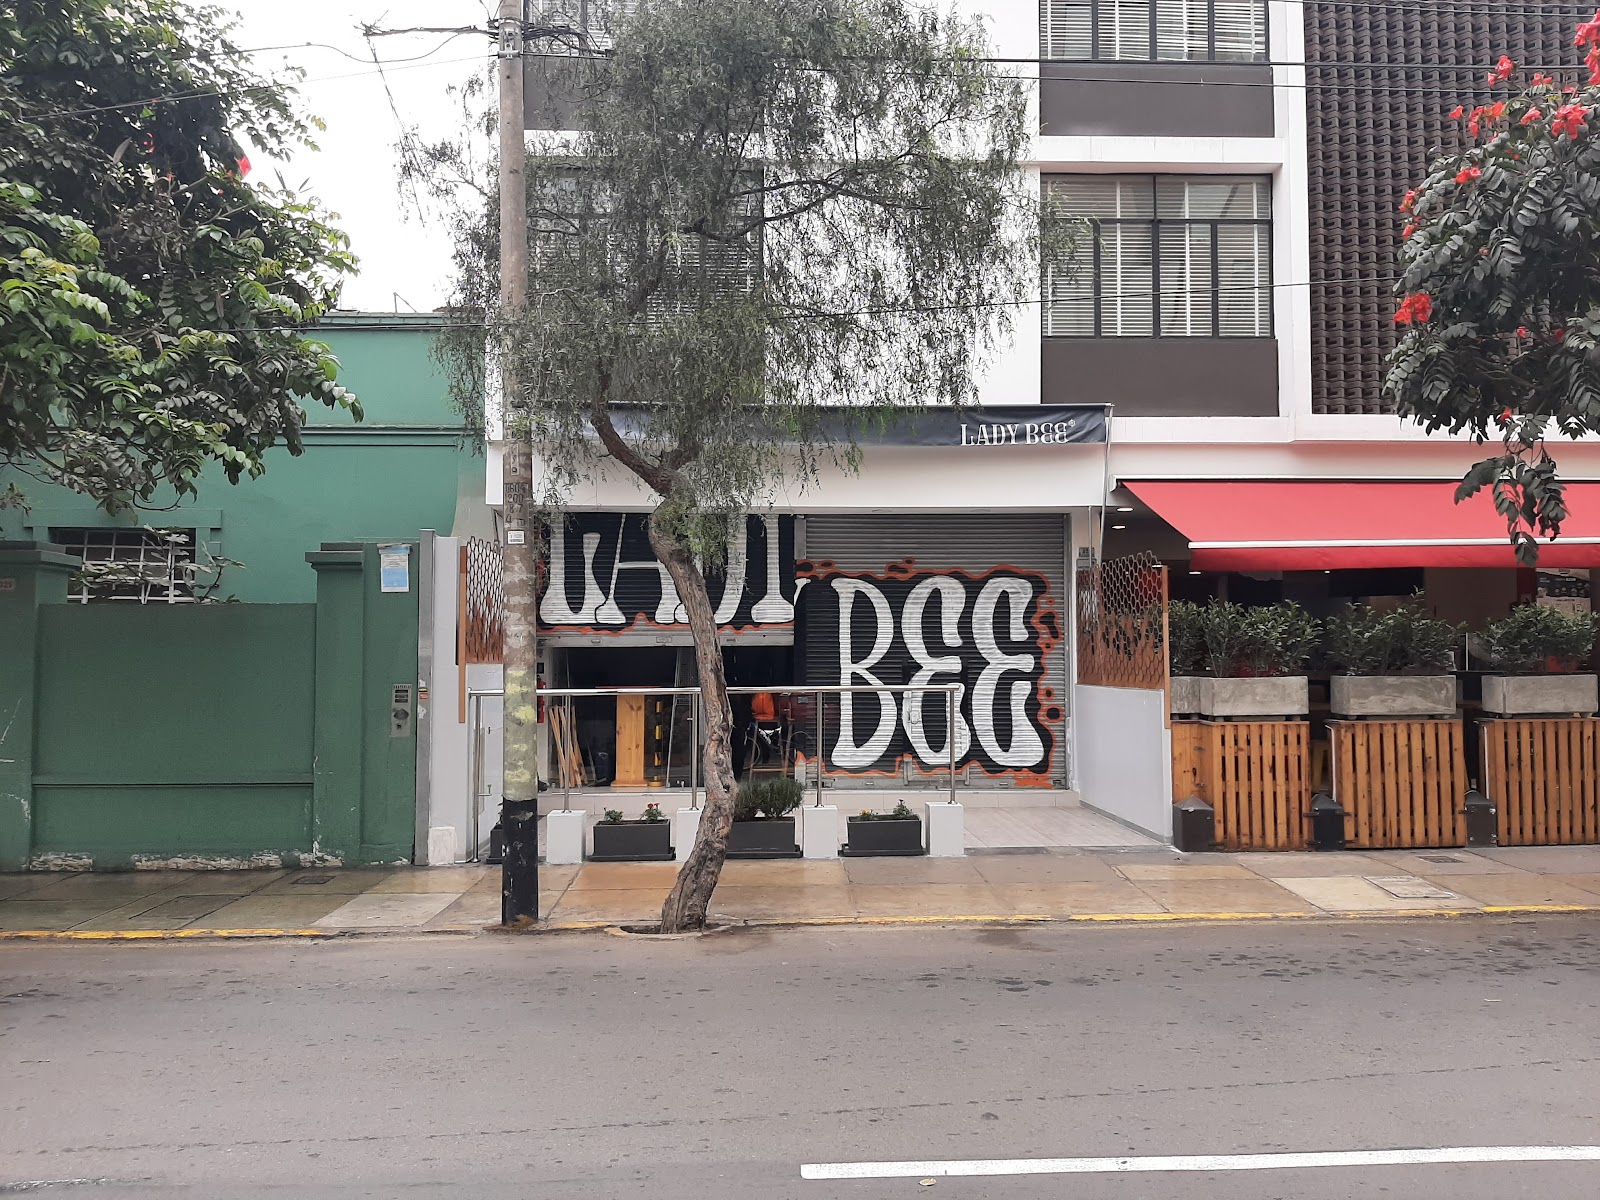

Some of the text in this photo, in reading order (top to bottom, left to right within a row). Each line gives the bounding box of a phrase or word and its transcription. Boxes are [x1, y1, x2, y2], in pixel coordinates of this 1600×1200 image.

[961, 422, 1069, 446] LADY BEE
[831, 576, 1045, 768] BEE
